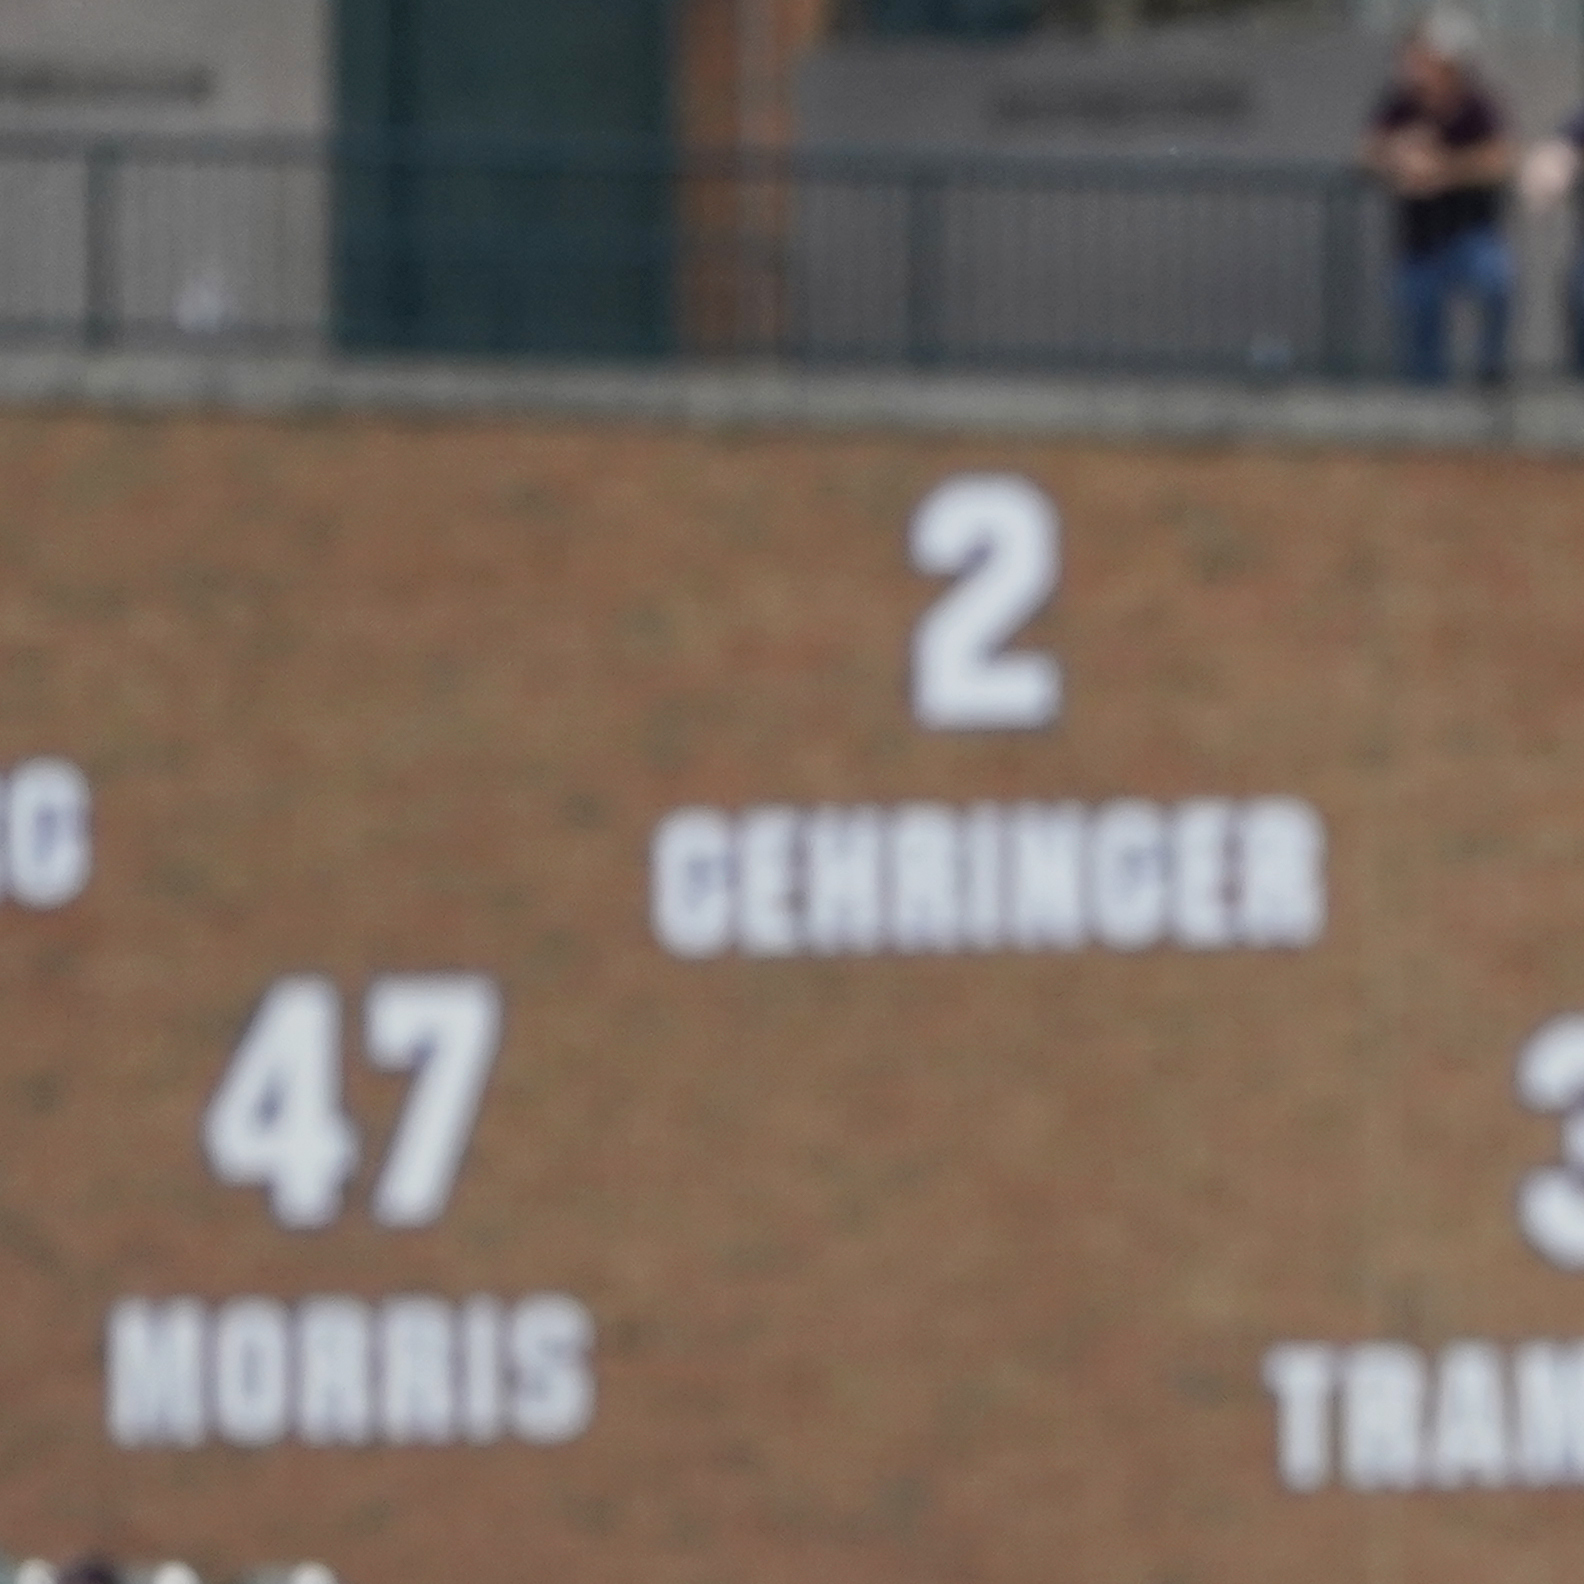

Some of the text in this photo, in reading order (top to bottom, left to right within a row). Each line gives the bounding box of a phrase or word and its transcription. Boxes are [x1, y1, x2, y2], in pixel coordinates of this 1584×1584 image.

[910, 474, 1061, 730] 2
[650, 798, 1326, 957] GEHRINGER
[203, 976, 500, 1226] 47
[106, 1295, 592, 1445] MORRIS
